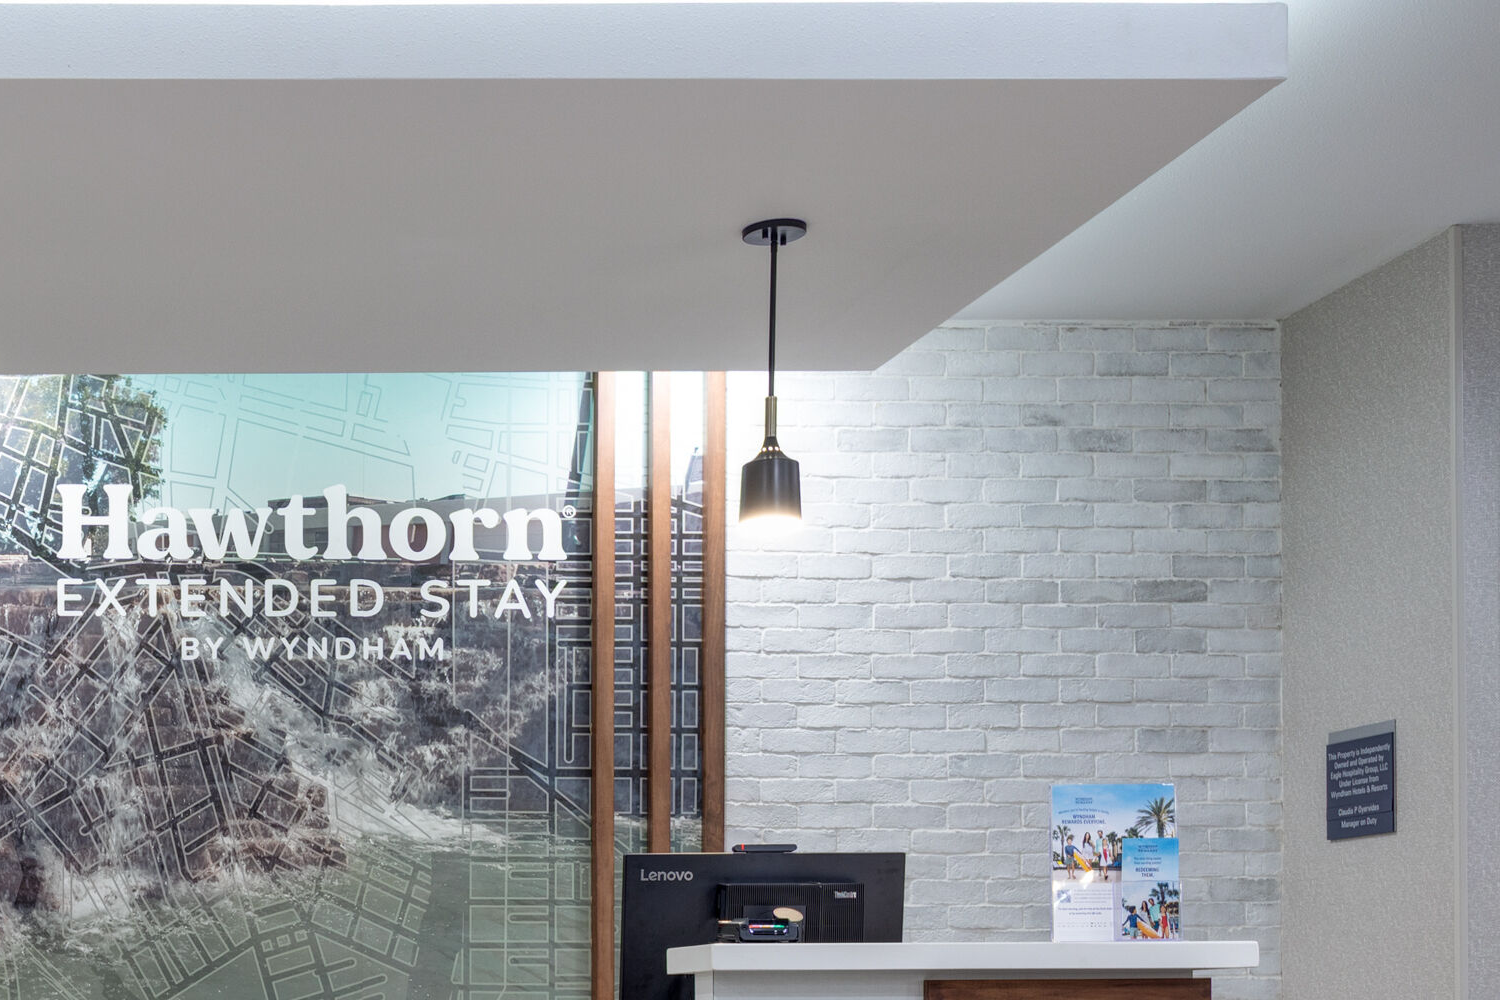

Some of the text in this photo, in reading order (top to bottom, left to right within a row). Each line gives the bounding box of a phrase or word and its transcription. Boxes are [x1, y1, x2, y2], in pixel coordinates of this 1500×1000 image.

[56, 578, 568, 618] EXTENDED STAY
[182, 637, 445, 661] BY WYNDHAM
[1328, 752, 1337, 760] This
[1337, 750, 1356, 759] Property
[1360, 743, 1390, 755] Independently
[1334, 760, 1349, 770] Owned
[1349, 759, 1358, 767] and
[1358, 754, 1378, 766] Operated
[1330, 771, 1342, 781] Eagle
[1342, 767, 1364, 778] Hospitality
[1379, 762, 1388, 771] LLC
[1339, 775, 1380, 788] Under License from
[1330, 790, 1352, 800] Wyndham
[1352, 786, 1366, 795] Hotels
[1370, 784, 1388, 792] Resorts
[1338, 807, 1354, 816] Claudia
[1341, 820, 1360, 829] Manager
[1366, 817, 1378, 826] Duty
[640, 869, 694, 882] Lenovo
